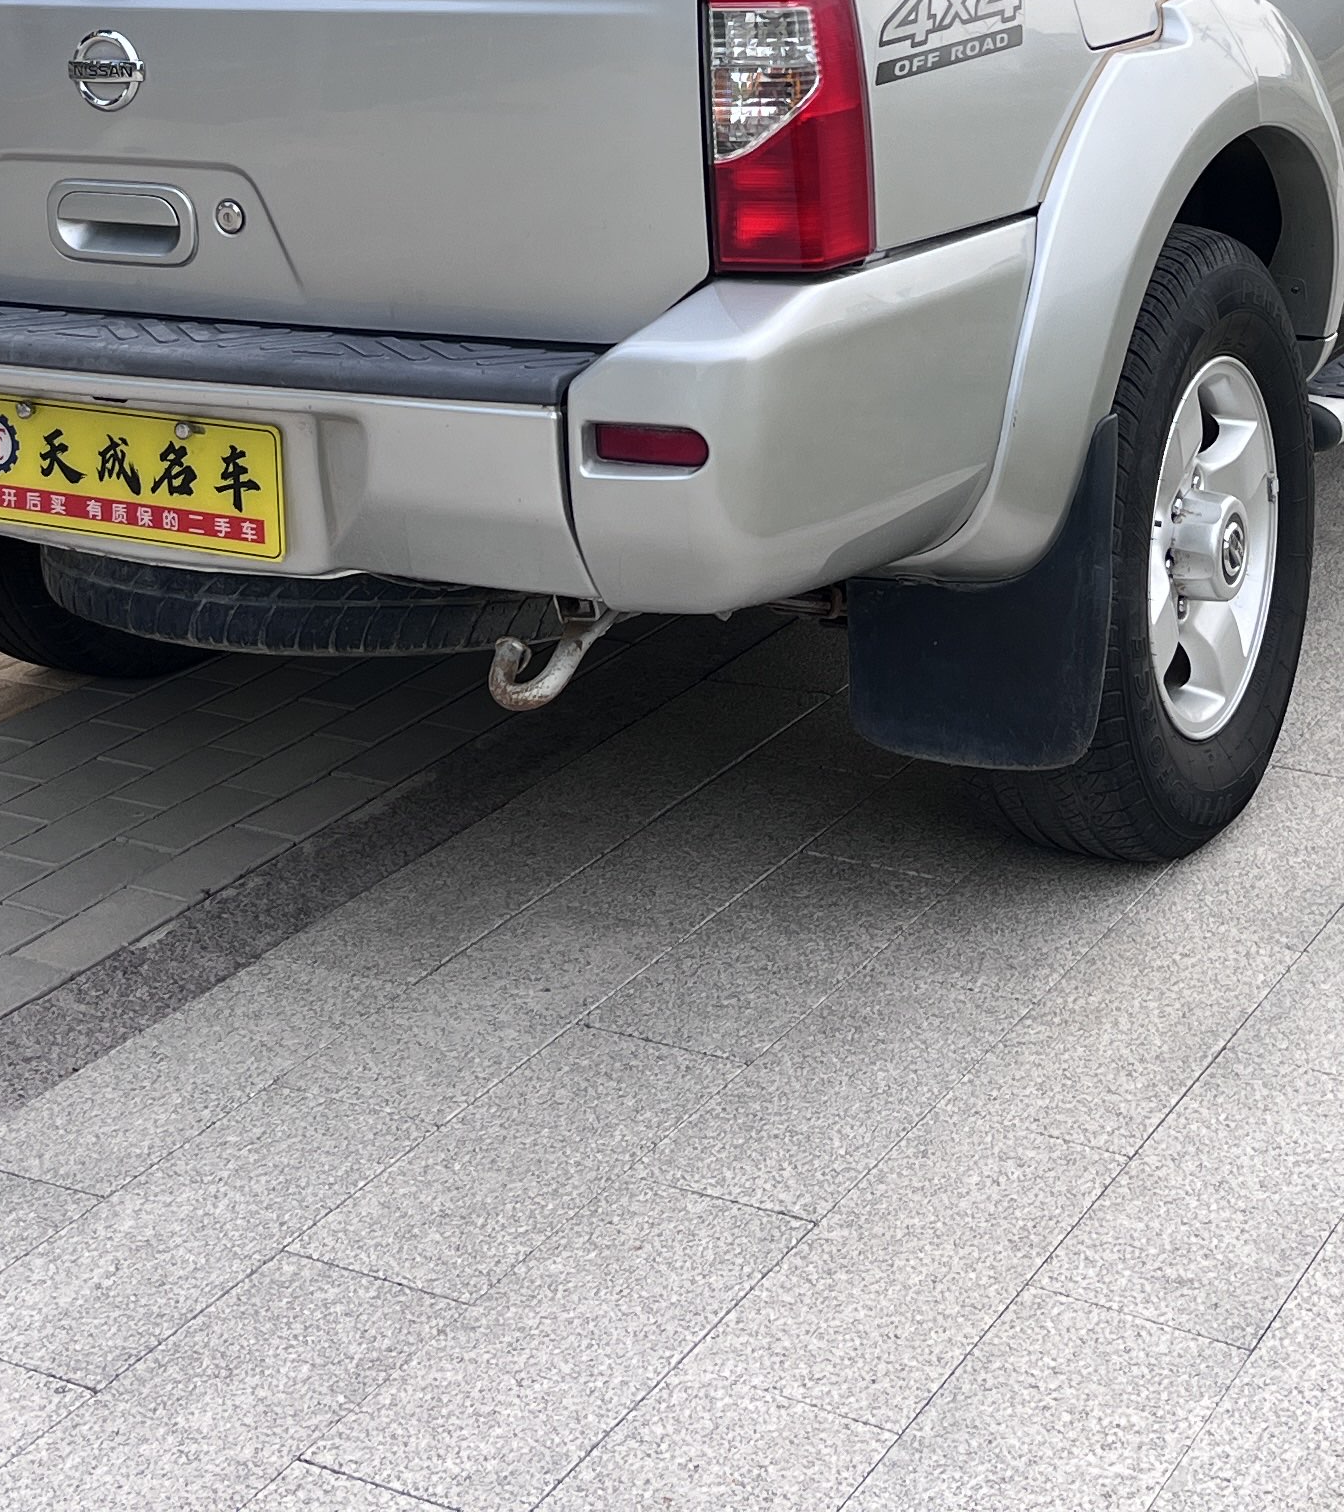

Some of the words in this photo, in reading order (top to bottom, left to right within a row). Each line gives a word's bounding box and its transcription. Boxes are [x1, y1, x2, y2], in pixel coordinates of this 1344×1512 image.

[73, 60, 133, 78] NISSAN
[893, 52, 941, 76] OFF
[950, 33, 1009, 61] ROAD
[39, 428, 262, 513] 天成名车
[86, 499, 258, 543] 有质保的二手车
